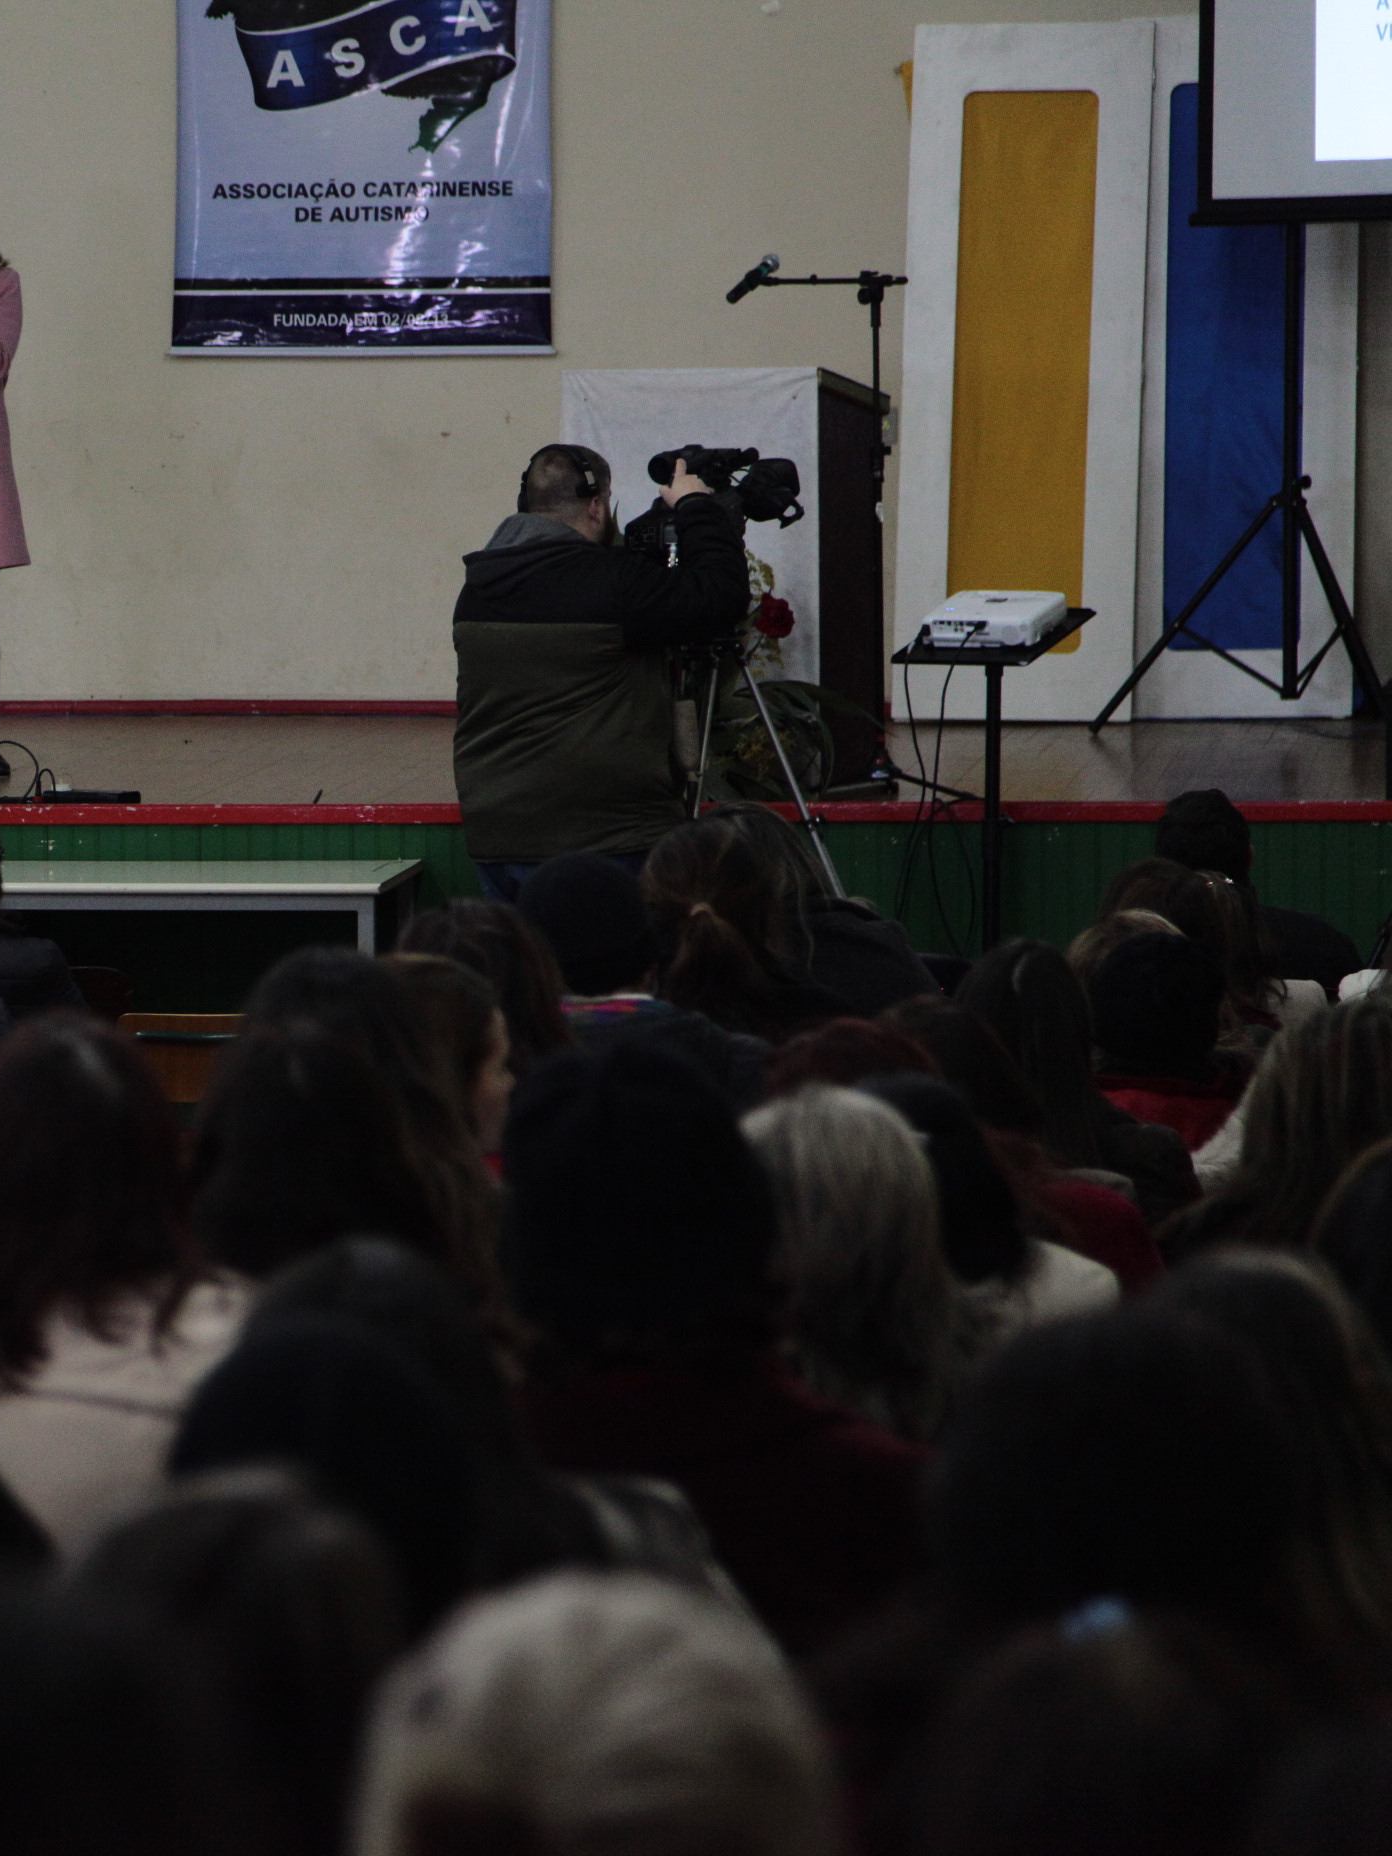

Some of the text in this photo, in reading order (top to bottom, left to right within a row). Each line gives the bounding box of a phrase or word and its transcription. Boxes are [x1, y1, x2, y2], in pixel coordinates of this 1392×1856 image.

[212, 178, 513, 202] ASSOCIAÇÃO CATARINENSE
[294, 206, 429, 223] DE AUTISMO
[273, 313, 349, 327] FUNDADA
[354, 312, 378, 327] EM
